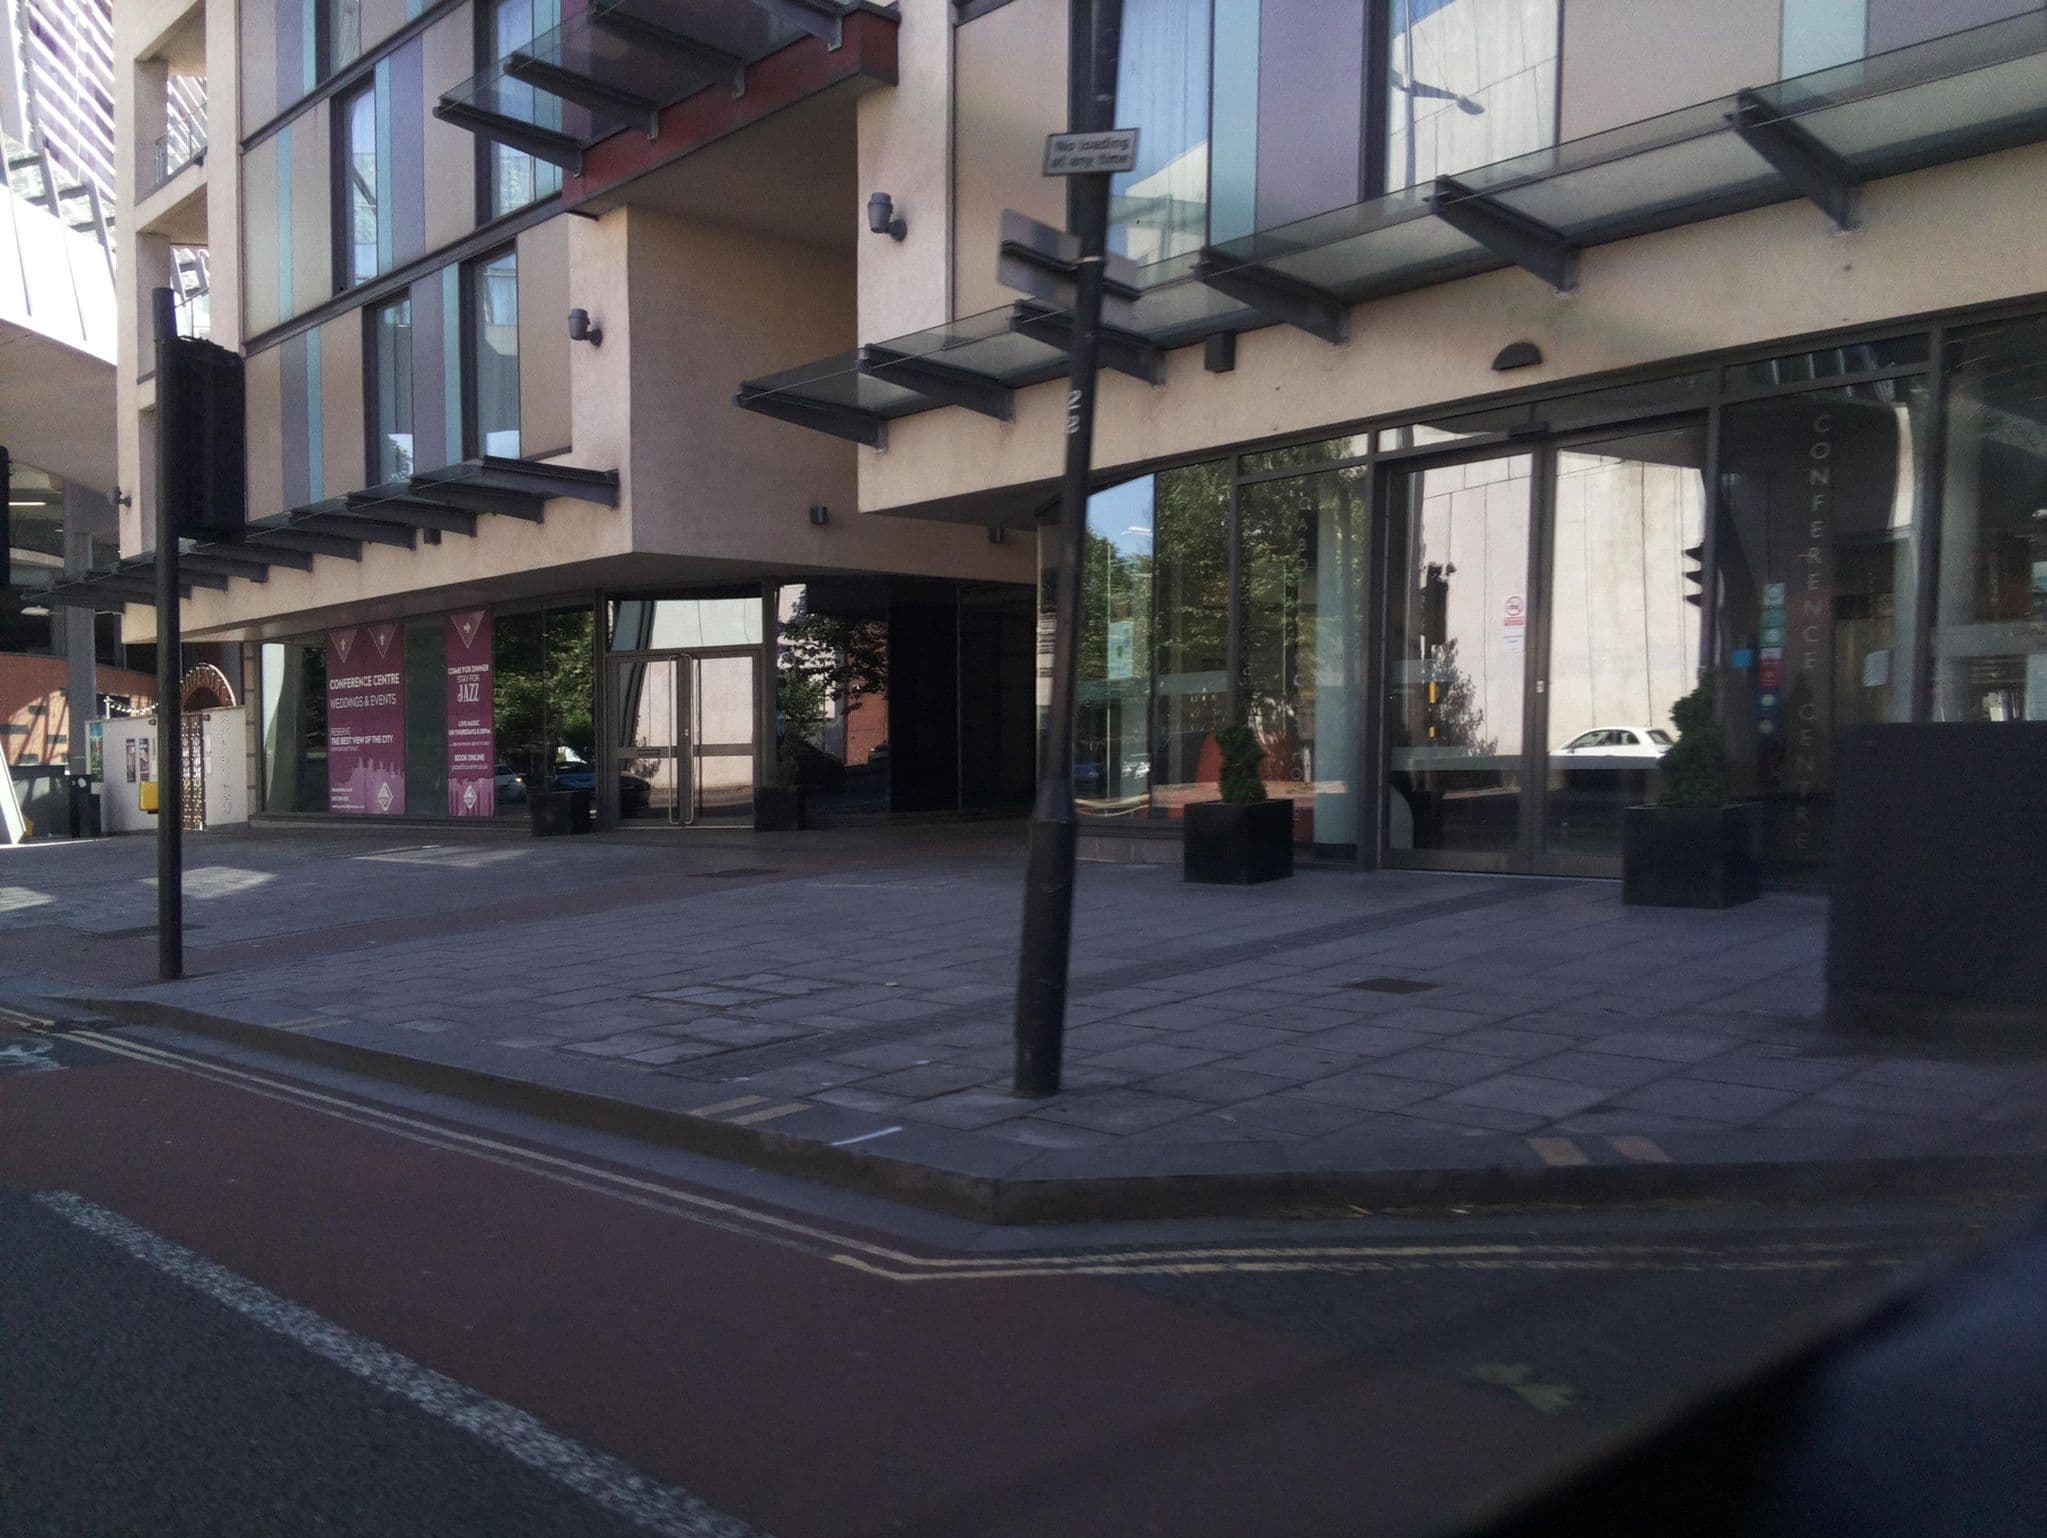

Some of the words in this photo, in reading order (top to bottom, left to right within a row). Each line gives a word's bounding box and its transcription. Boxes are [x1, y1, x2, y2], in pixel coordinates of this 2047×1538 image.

[1802, 413, 1832, 669] CONFERENCE
[330, 676, 372, 689] CONFERENCE
[373, 672, 400, 686] CENTRE
[330, 696, 363, 709] WEDDINGS
[364, 695, 370, 707] &
[370, 693, 397, 707] EVENTS
[457, 683, 480, 702] JAZZ
